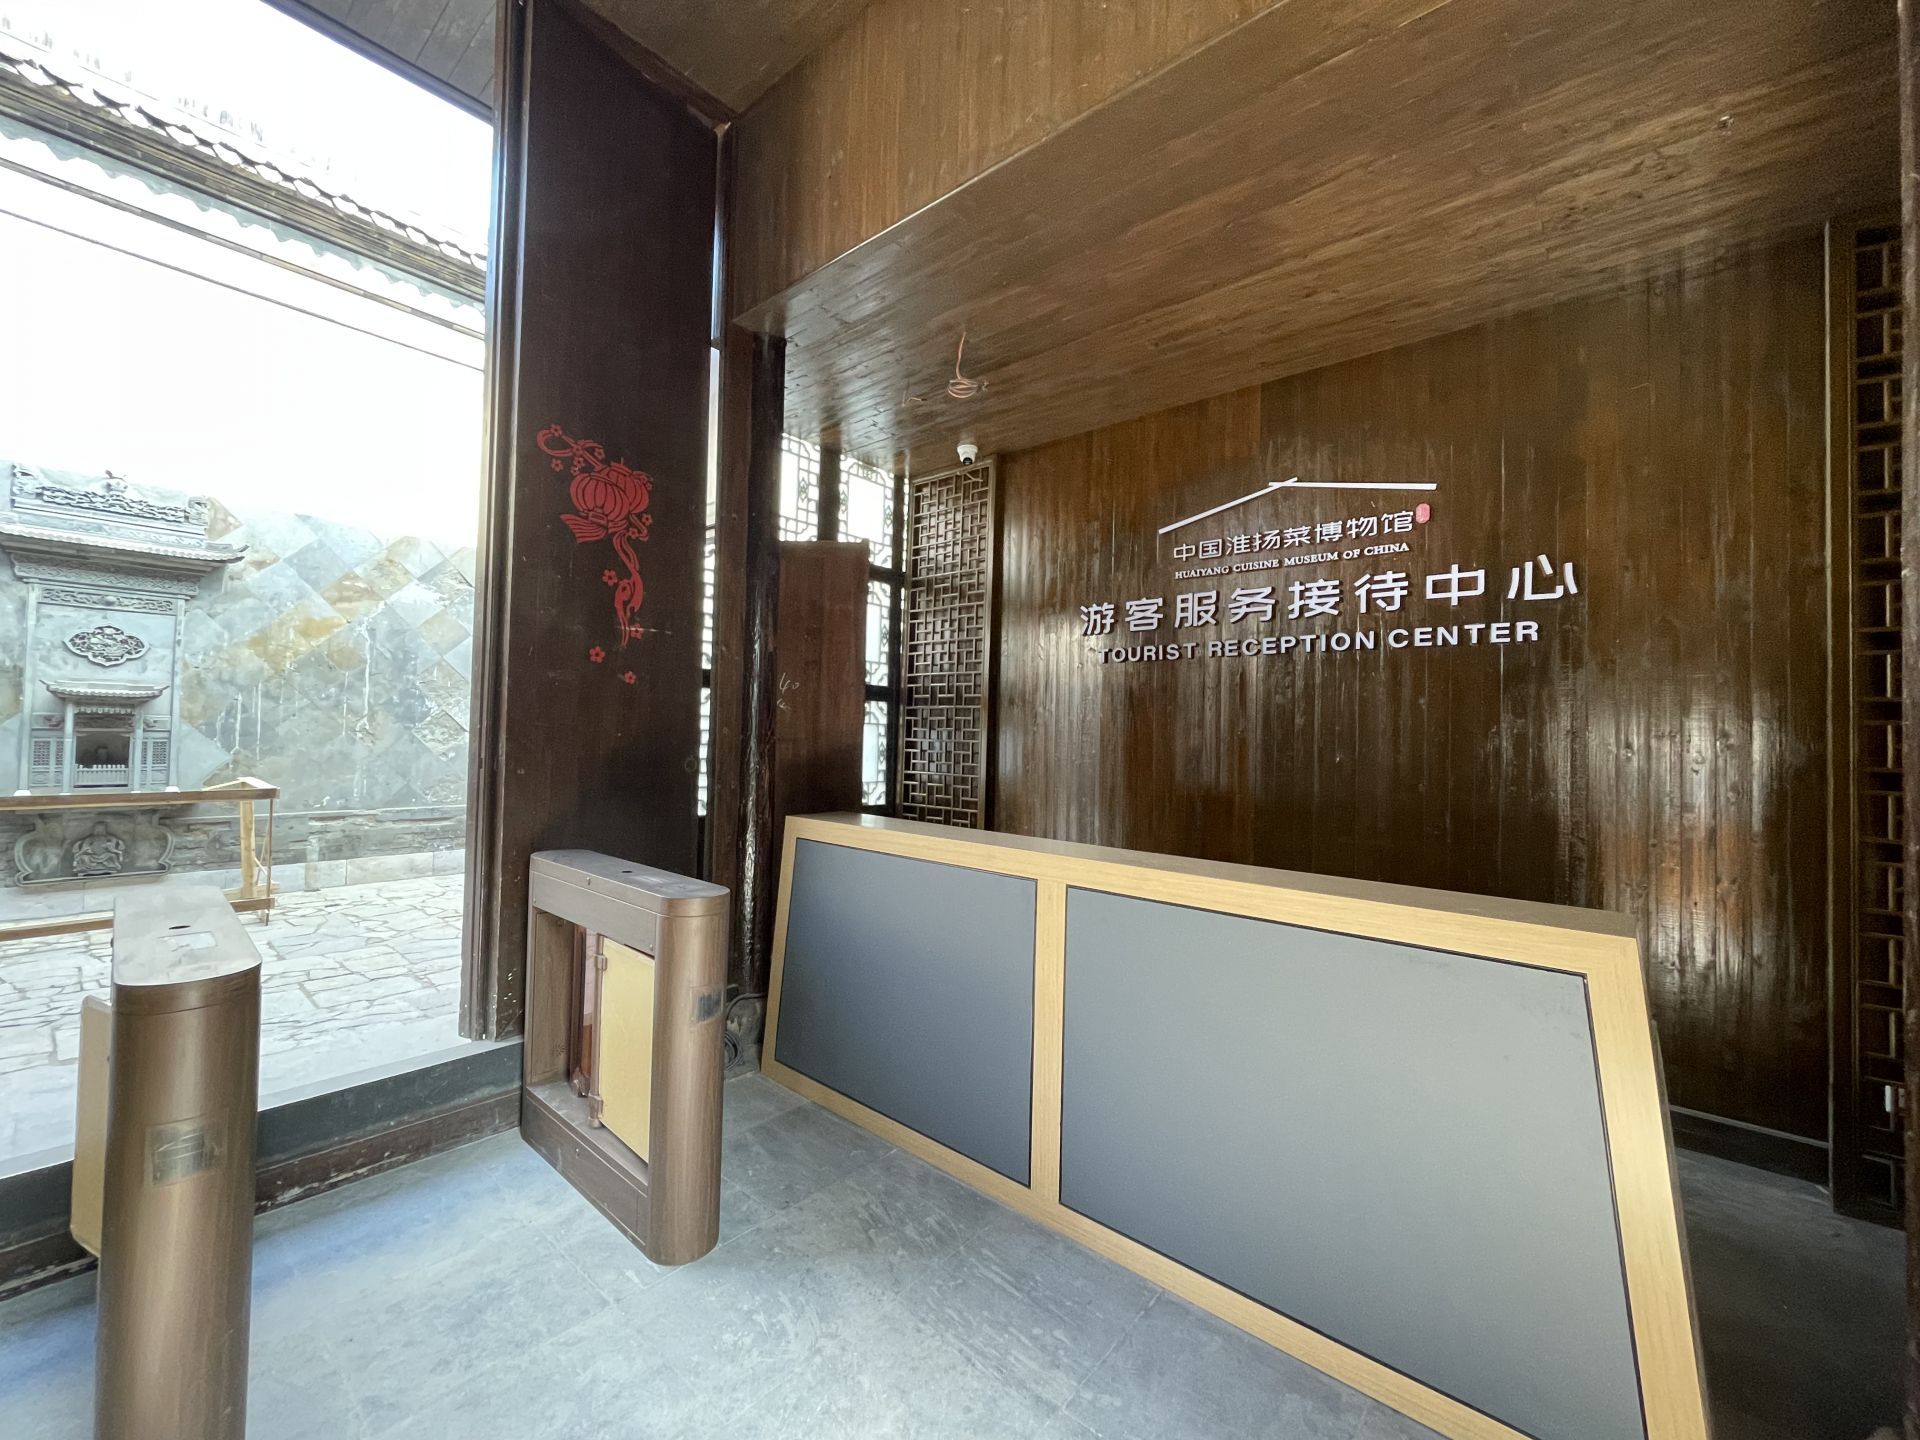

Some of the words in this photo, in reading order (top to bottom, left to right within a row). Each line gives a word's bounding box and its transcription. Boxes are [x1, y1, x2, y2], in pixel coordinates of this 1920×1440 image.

[1173, 509, 1414, 562] 中国淮扬菜博物馆
[1175, 565, 1230, 579] HUAIYANG
[1233, 558, 1280, 572] CUISINE
[1284, 551, 1339, 567] MUSEUM
[1343, 549, 1360, 559] OF
[1364, 542, 1410, 556] CHINA
[1080, 554, 1579, 636] 游客服务接待中心
[1100, 642, 1198, 664] TOURIST
[1208, 631, 1375, 657] RECEPTION
[1388, 620, 1539, 648] CENTER
